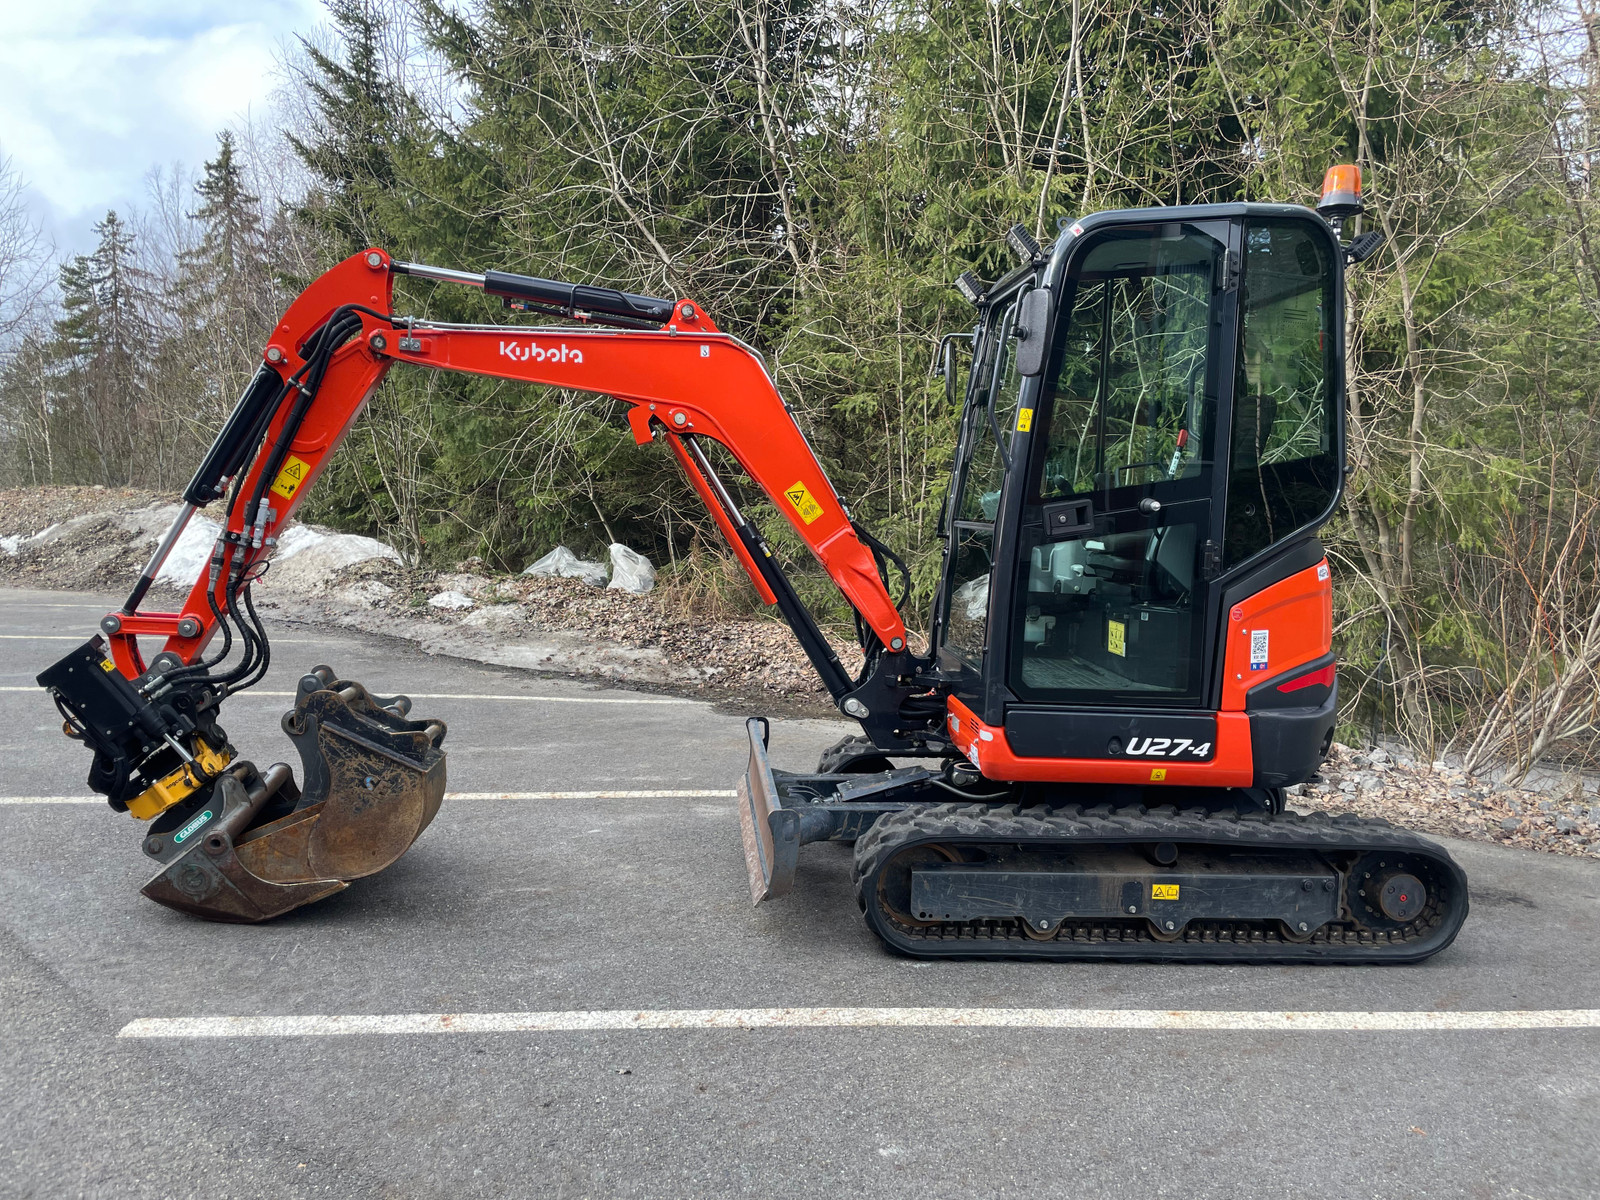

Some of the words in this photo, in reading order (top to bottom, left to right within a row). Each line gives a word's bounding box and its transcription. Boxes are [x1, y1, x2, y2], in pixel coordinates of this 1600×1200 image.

[500, 341, 583, 363] Kubota
[1125, 737, 1211, 757] U27-4
[165, 775, 186, 790] engcon
[179, 814, 208, 839] GLOBUS
